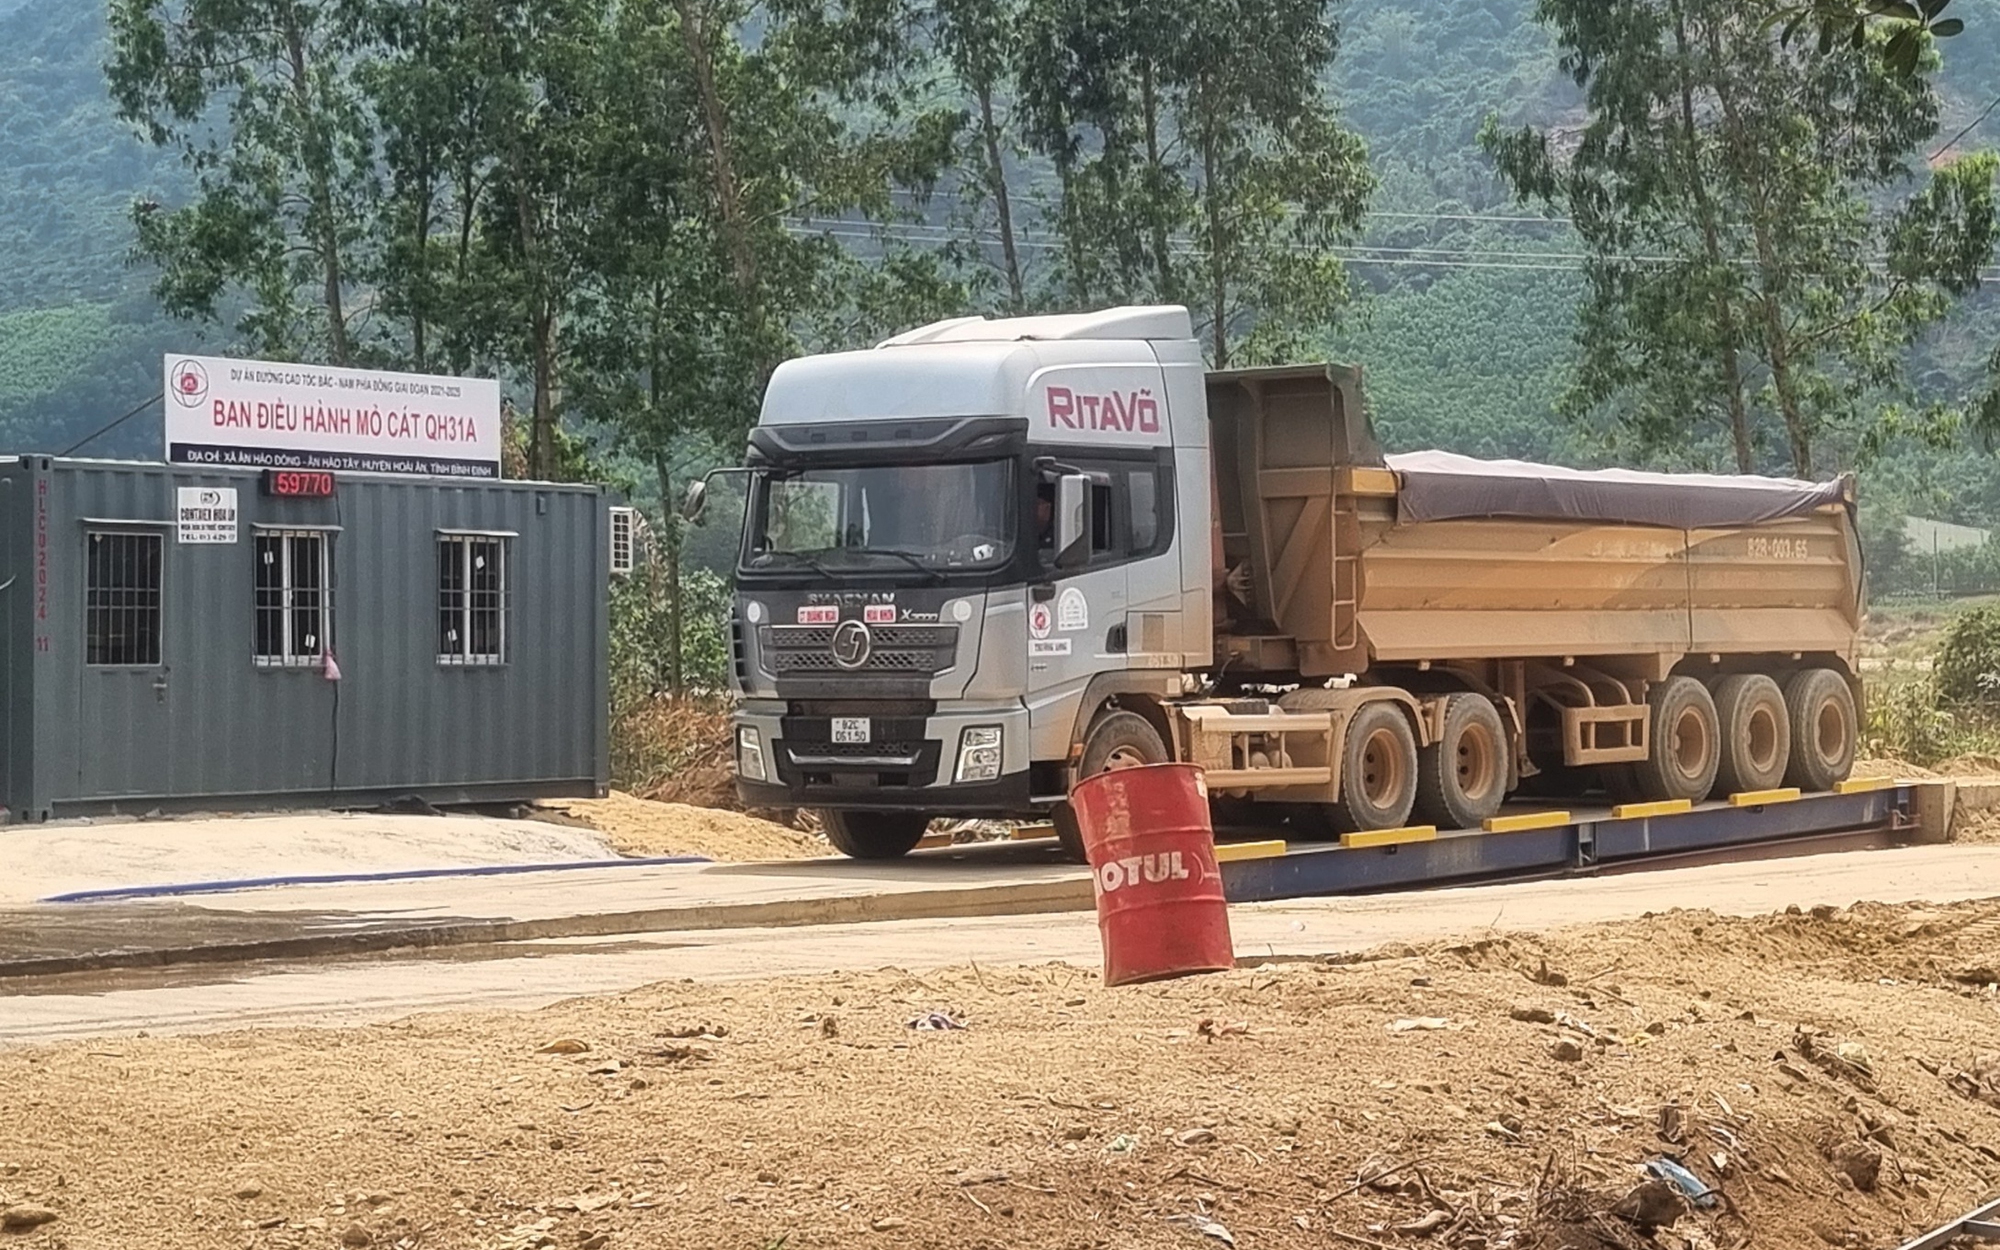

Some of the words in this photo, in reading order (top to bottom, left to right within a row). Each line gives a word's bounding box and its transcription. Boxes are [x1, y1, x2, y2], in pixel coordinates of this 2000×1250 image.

[285, 372, 301, 385] CAO
[214, 400, 251, 427] BAN
[303, 399, 351, 434] HÀNH
[388, 405, 421, 438] CÁT
[426, 414, 477, 442] QH31A
[278, 473, 331, 495] 59770
